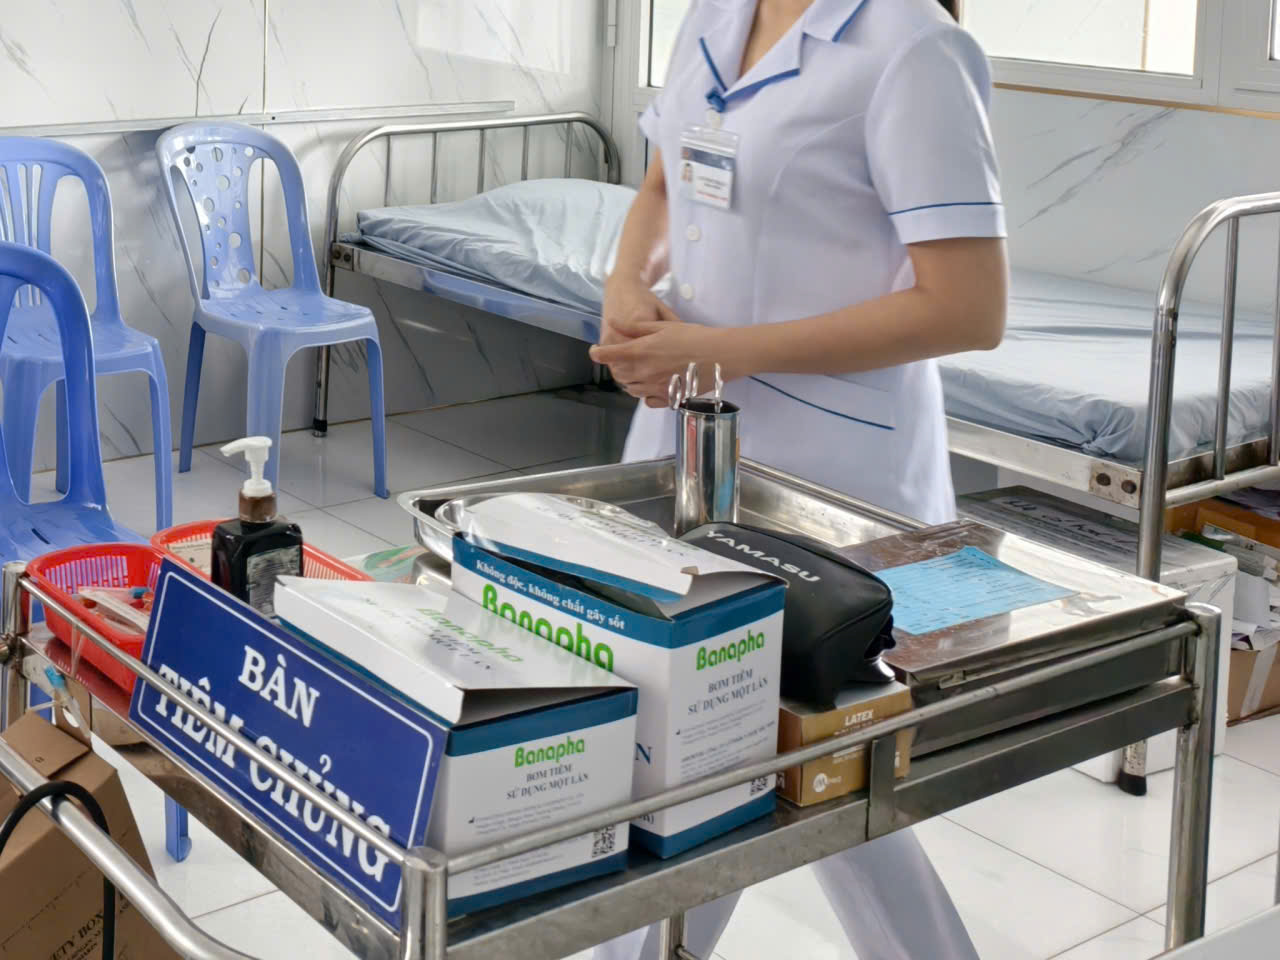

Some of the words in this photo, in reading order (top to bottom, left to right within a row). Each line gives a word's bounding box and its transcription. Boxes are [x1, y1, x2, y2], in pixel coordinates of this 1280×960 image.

[706, 530, 821, 582] YAMASU
[476, 559, 506, 584] Không
[507, 573, 527, 592] độc,
[528, 583, 560, 607] không
[562, 598, 585, 615] chất
[586, 608, 606, 625] gây
[608, 614, 625, 630] sốt
[696, 629, 765, 671] Banapha
[238, 644, 320, 727] BÀN
[703, 693, 729, 712] DỤNG
[731, 685, 751, 701] MỘT
[752, 676, 769, 693] LẦN
[708, 677, 730, 693] BƠM
[732, 668, 754, 685] TIÊM
[844, 708, 874, 727] LATEX
[514, 736, 585, 768] Banapha
[155, 664, 245, 769] TIÊM
[249, 735, 392, 882] CHỦNG
[521, 783, 547, 798] DỤNG
[549, 777, 569, 790] MỘT
[570, 771, 589, 785] LẦN
[526, 769, 547, 783] BƠM
[549, 763, 573, 777] TIÊM
